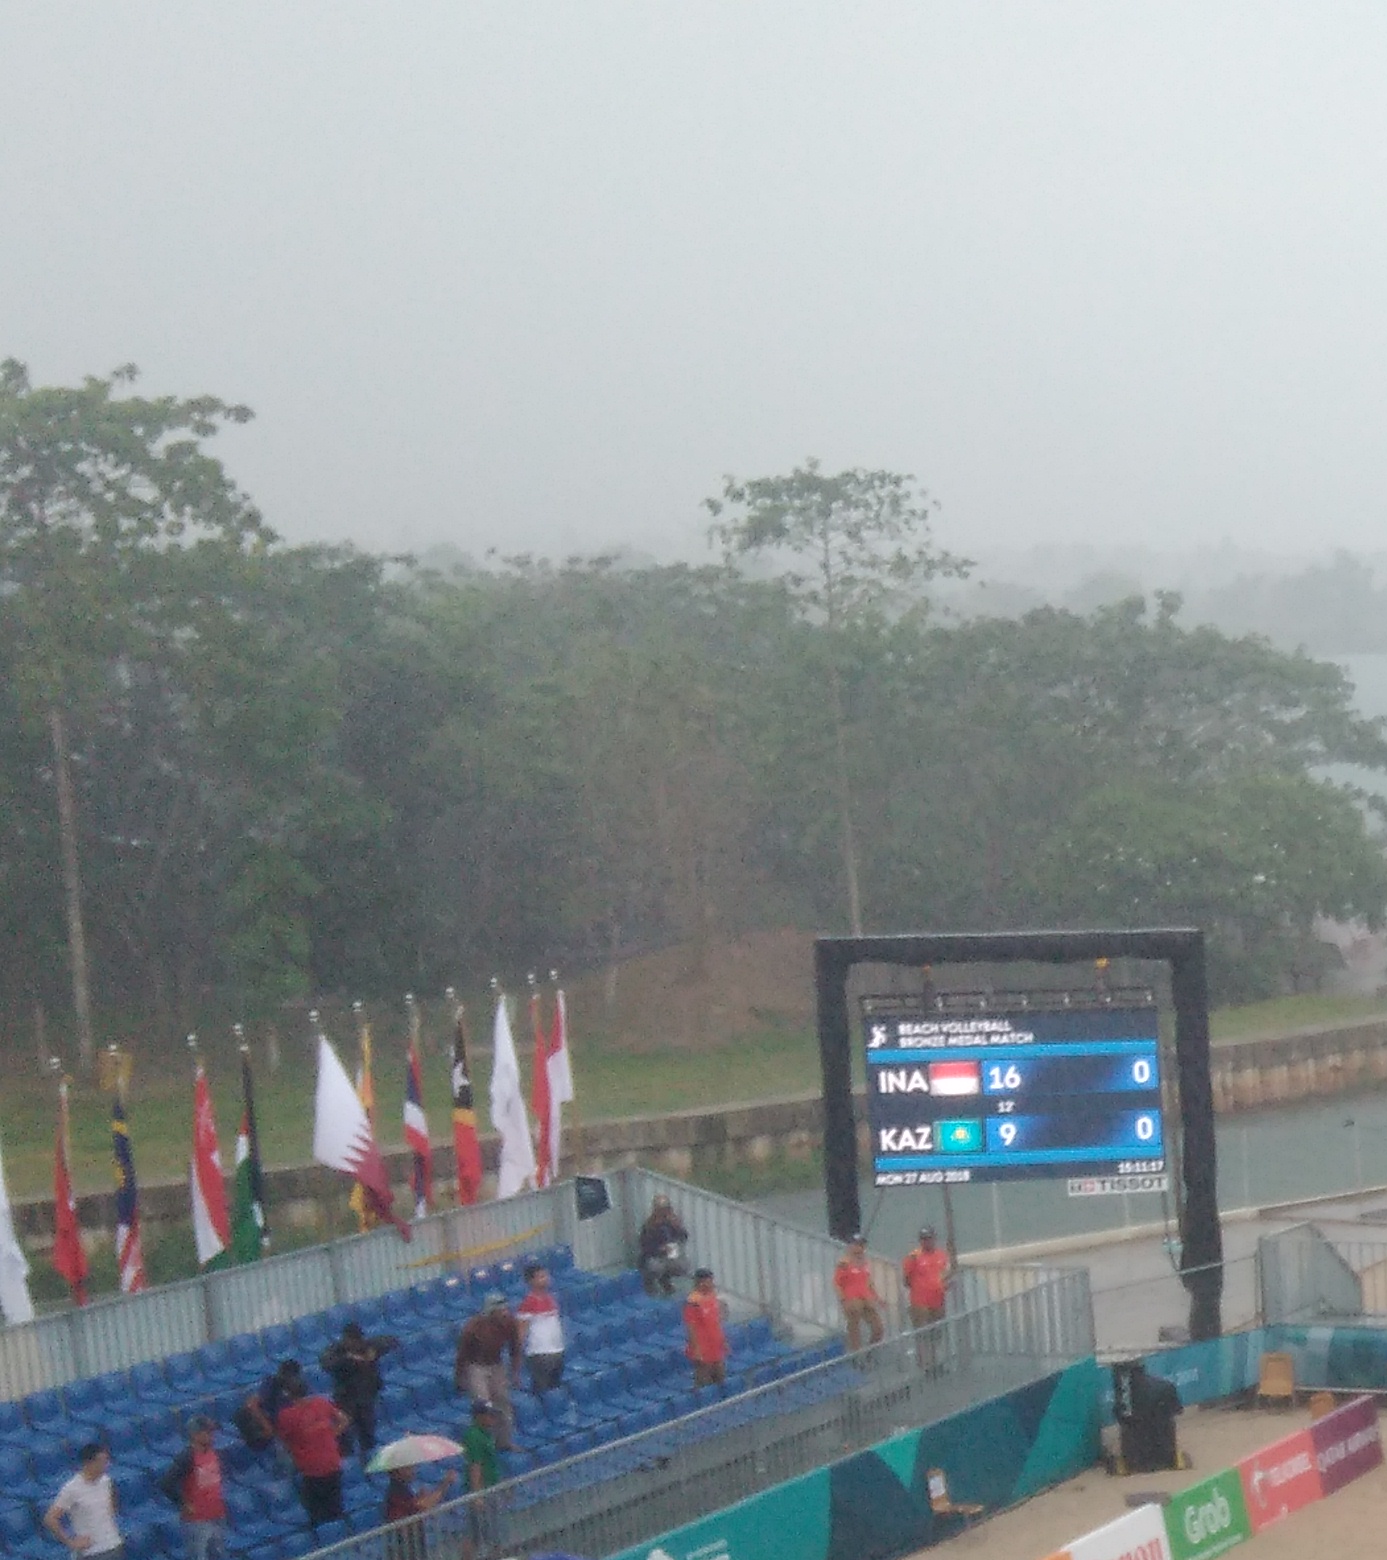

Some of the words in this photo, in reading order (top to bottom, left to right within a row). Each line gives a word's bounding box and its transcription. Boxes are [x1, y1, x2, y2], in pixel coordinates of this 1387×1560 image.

[879, 1072, 930, 1094] INA
[990, 1066, 1021, 1089] 16
[1133, 1060, 1150, 1083] 0
[880, 1127, 933, 1151] KAZ
[999, 1123, 1017, 1147] 9
[1136, 1118, 1153, 1140] 0
[1184, 1487, 1231, 1544] Grab
